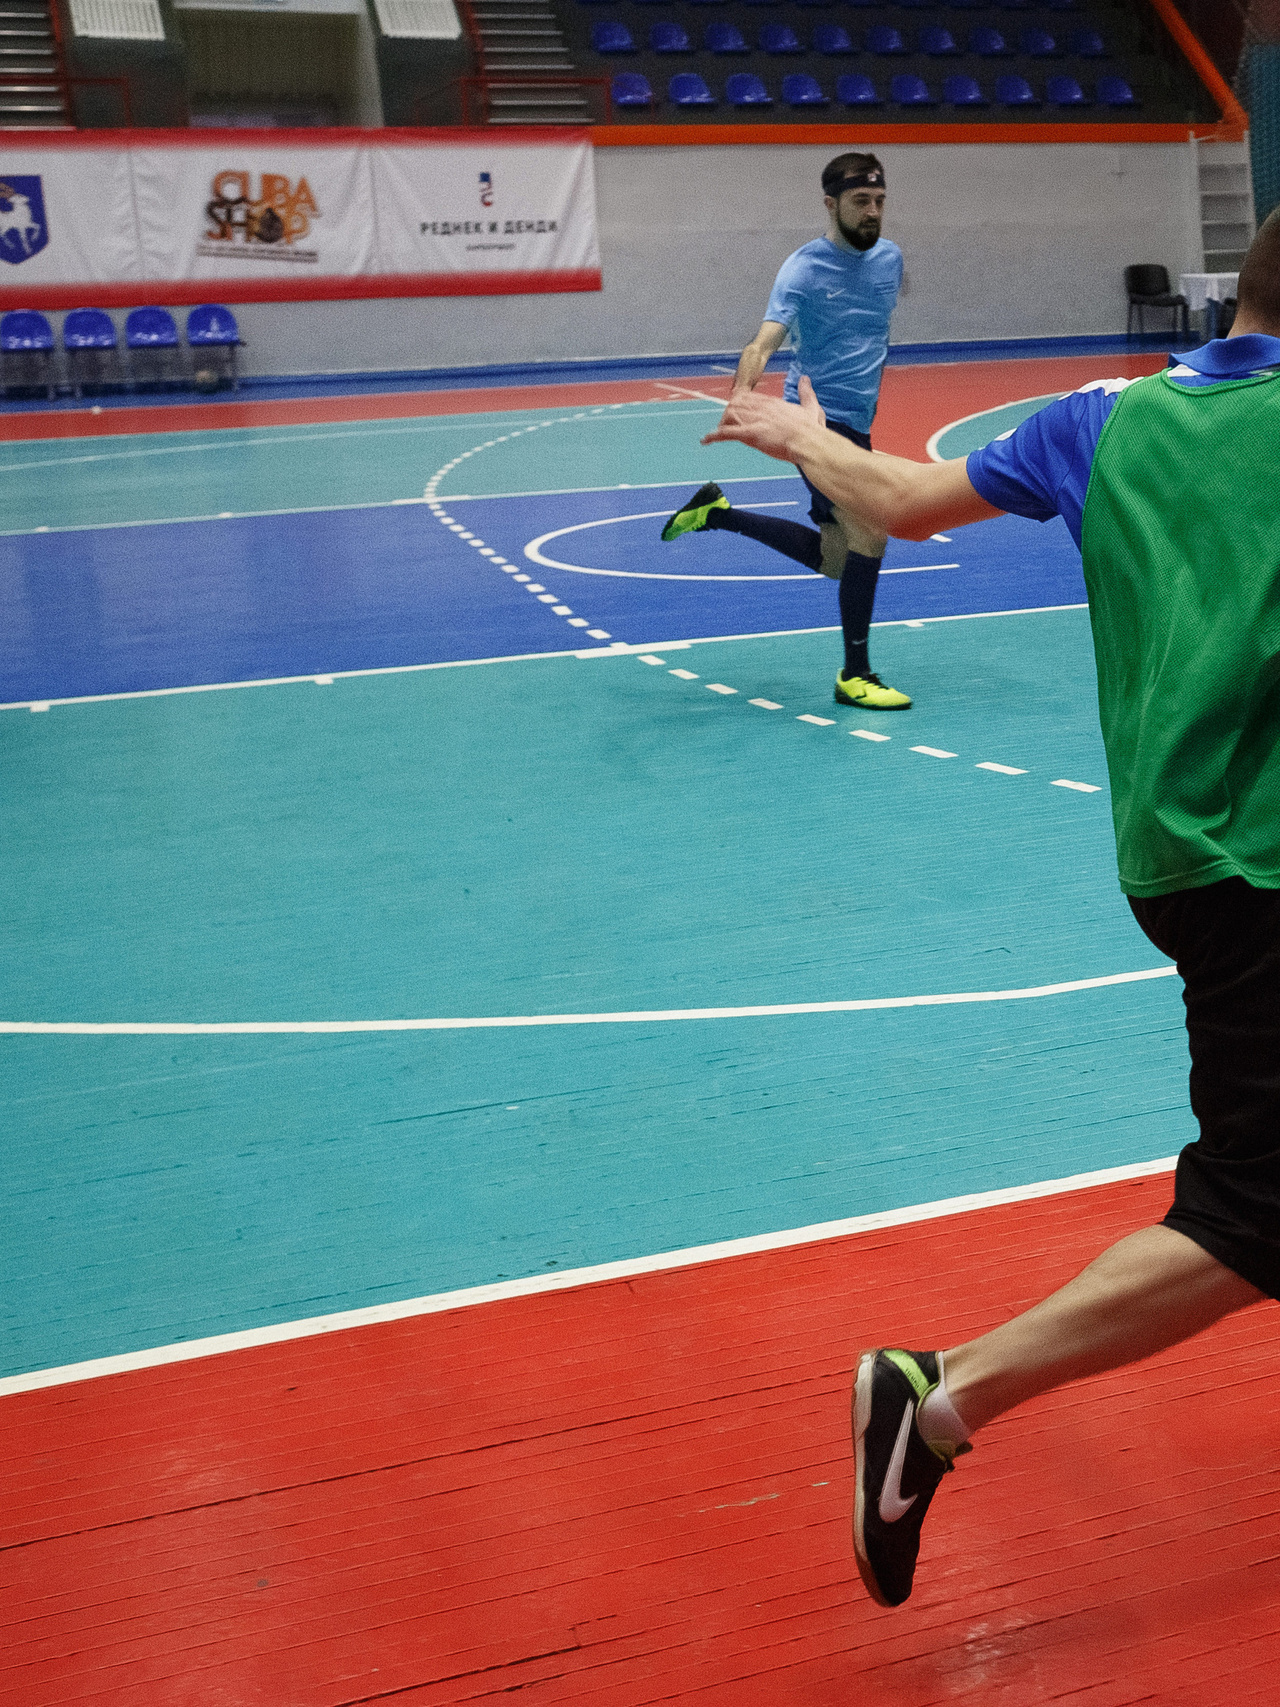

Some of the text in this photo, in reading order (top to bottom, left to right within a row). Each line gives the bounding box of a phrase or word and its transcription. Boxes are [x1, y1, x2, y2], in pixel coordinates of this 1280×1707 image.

[212, 169, 319, 214] CUBA
[420, 219, 558, 236] РЕДНЕК И ДЕНДИ
